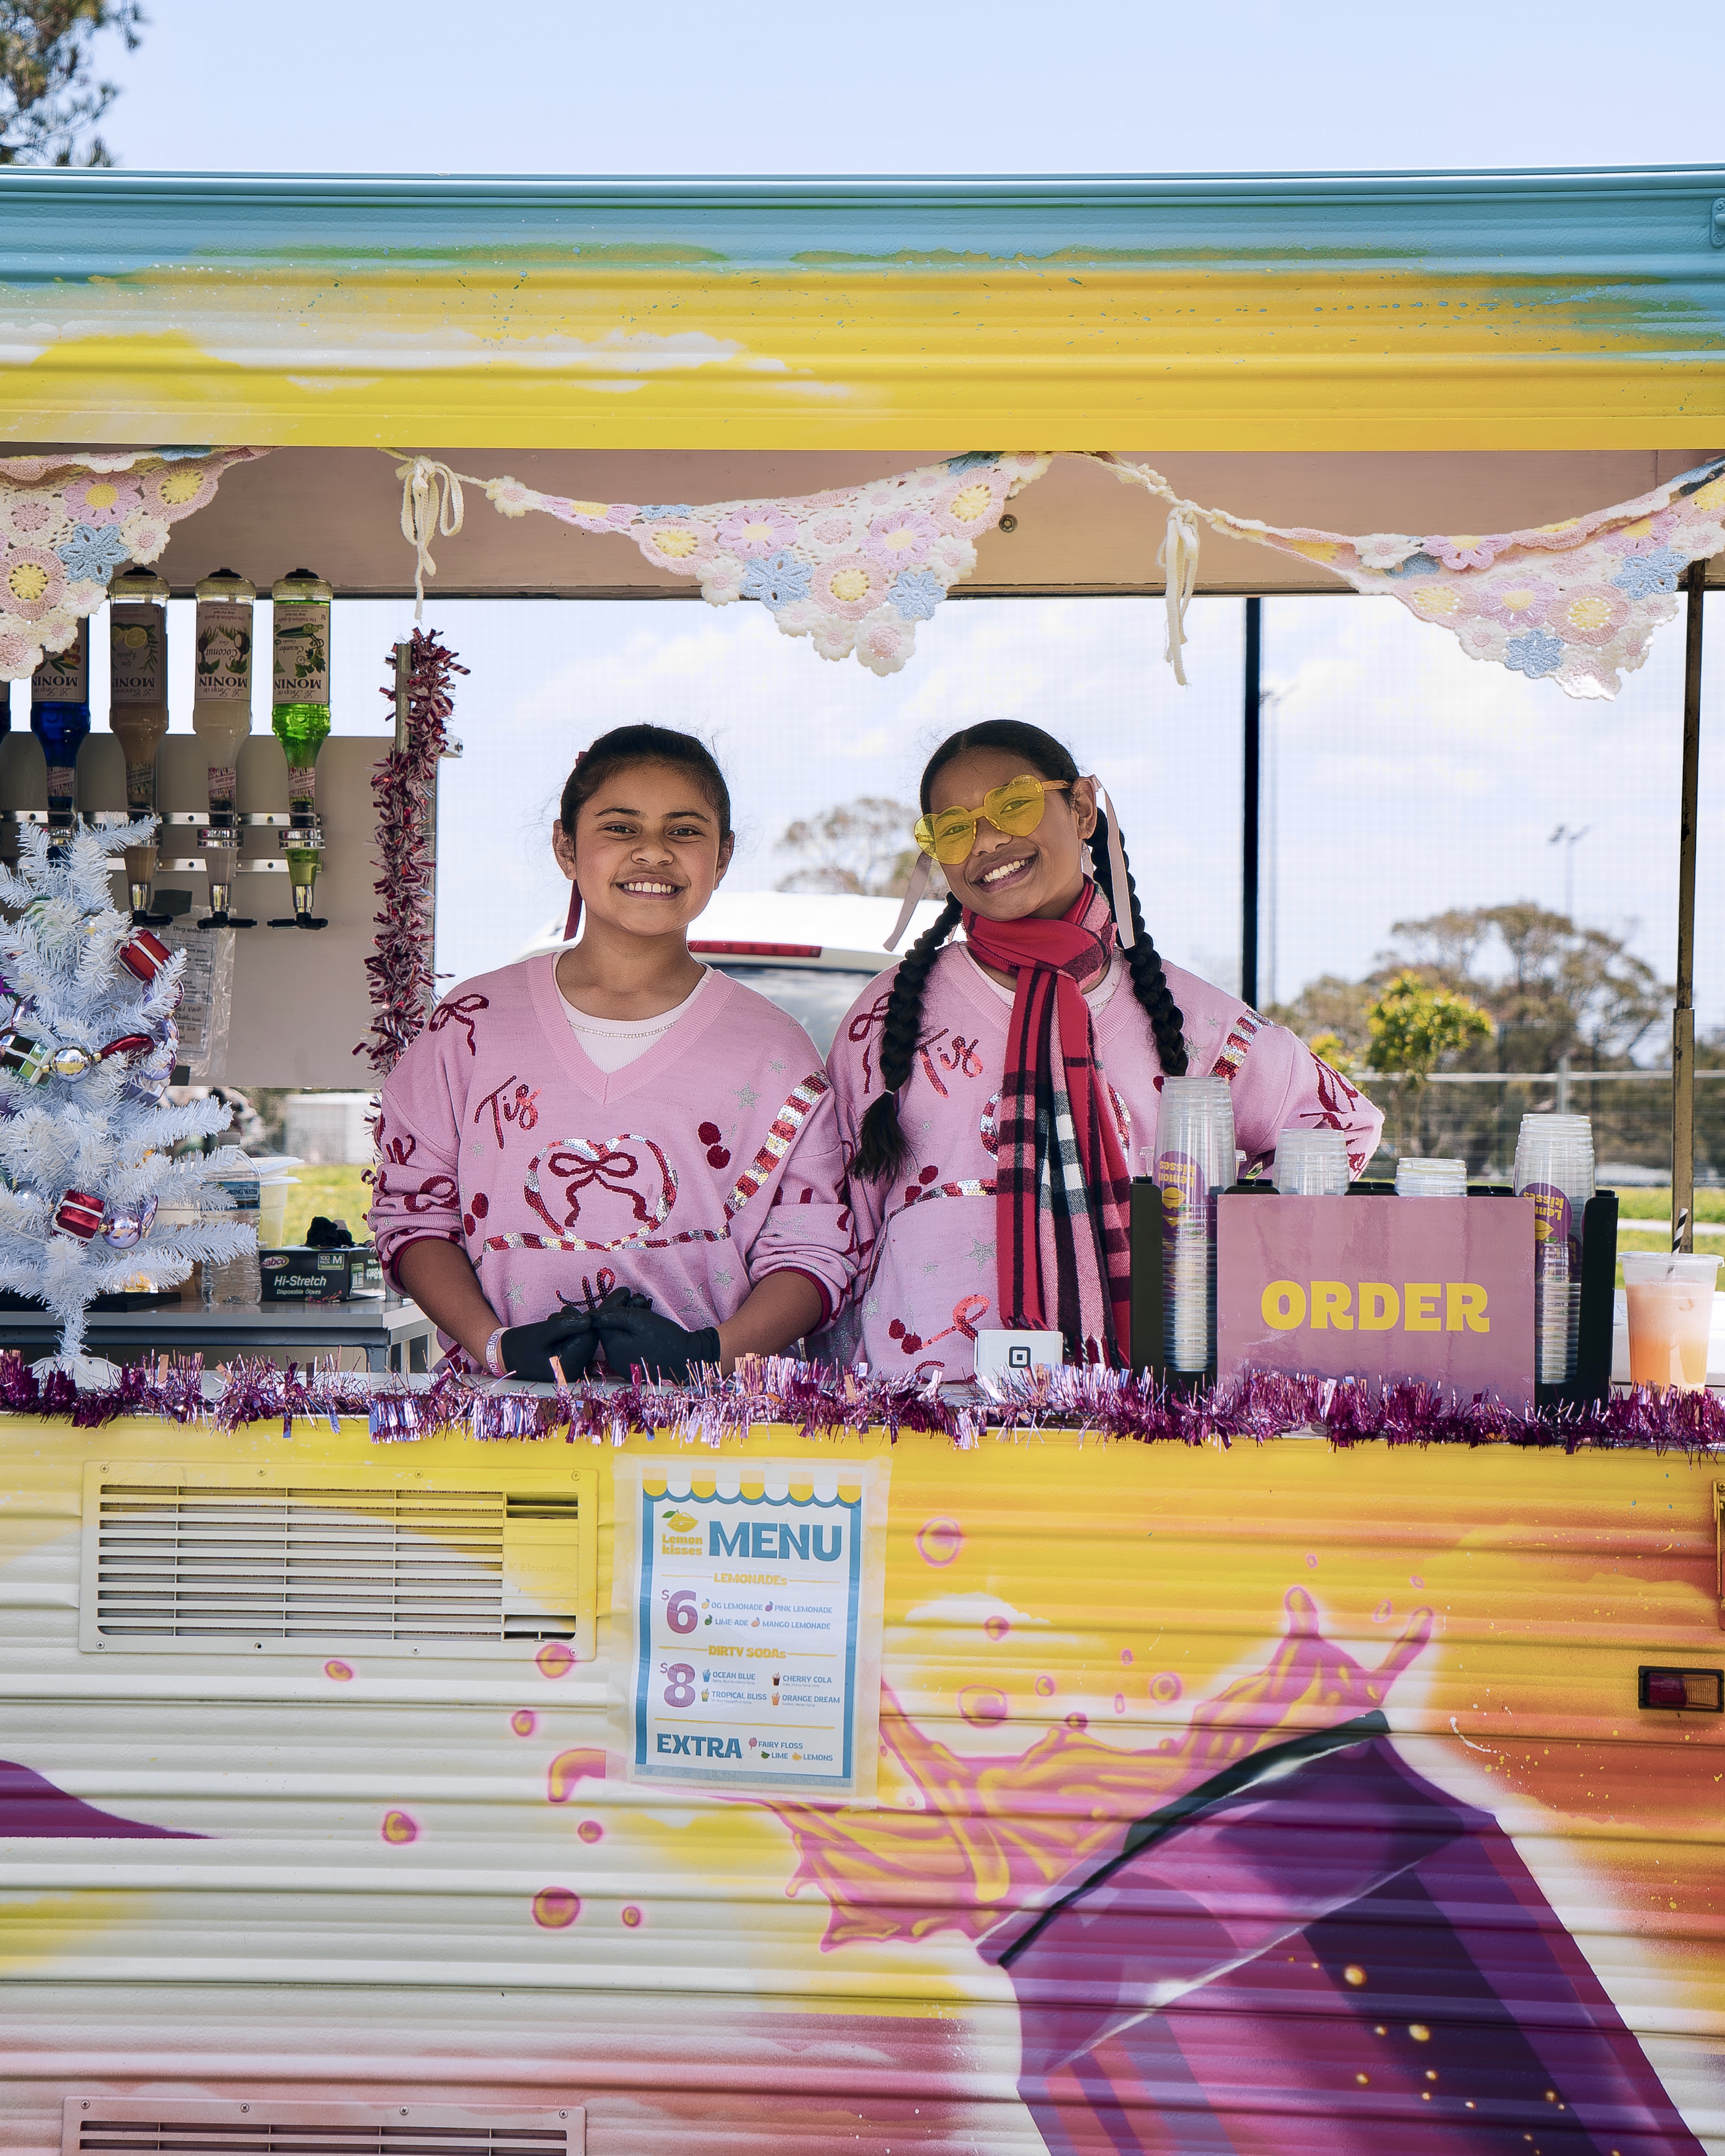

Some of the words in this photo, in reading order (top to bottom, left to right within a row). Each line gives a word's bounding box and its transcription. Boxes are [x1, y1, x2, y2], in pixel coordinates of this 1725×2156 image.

[205, 648, 237, 660] Coconut
[199, 677, 248, 688] MONIN
[1159, 1161, 1196, 1176] kisses
[1158, 1172, 1195, 1187] Lemon
[1535, 1206, 1562, 1220] Lem
[261, 1257, 287, 1268] sabco
[333, 1256, 342, 1264] M
[274, 1275, 327, 1286] Hi-Stretch
[1261, 1281, 1490, 1334] ORDER
[488, 1332, 500, 1355] LOVES
[488, 1359, 500, 1373] YOU
[662, 1534, 703, 1545] Lemon
[709, 1521, 842, 1561] MENU
[662, 1544, 703, 1556] kisses
[521, 1562, 573, 1572] Electrolux
[714, 1573, 788, 1586] LEMONADEs
[723, 1602, 763, 1610] LEMONADE
[775, 1605, 792, 1613] PINK
[715, 1618, 749, 1626] LIME-ADE
[762, 1620, 789, 1628] MANGO
[791, 1621, 831, 1629] LEMONADE
[708, 1645, 744, 1658] DIRTY
[745, 1646, 787, 1659] SODAs
[712, 1691, 745, 1699] TROPICAL
[657, 1733, 743, 1758] EXTRA
[758, 1741, 779, 1749] FAIRY
[803, 1754, 833, 1762] LEMONS
